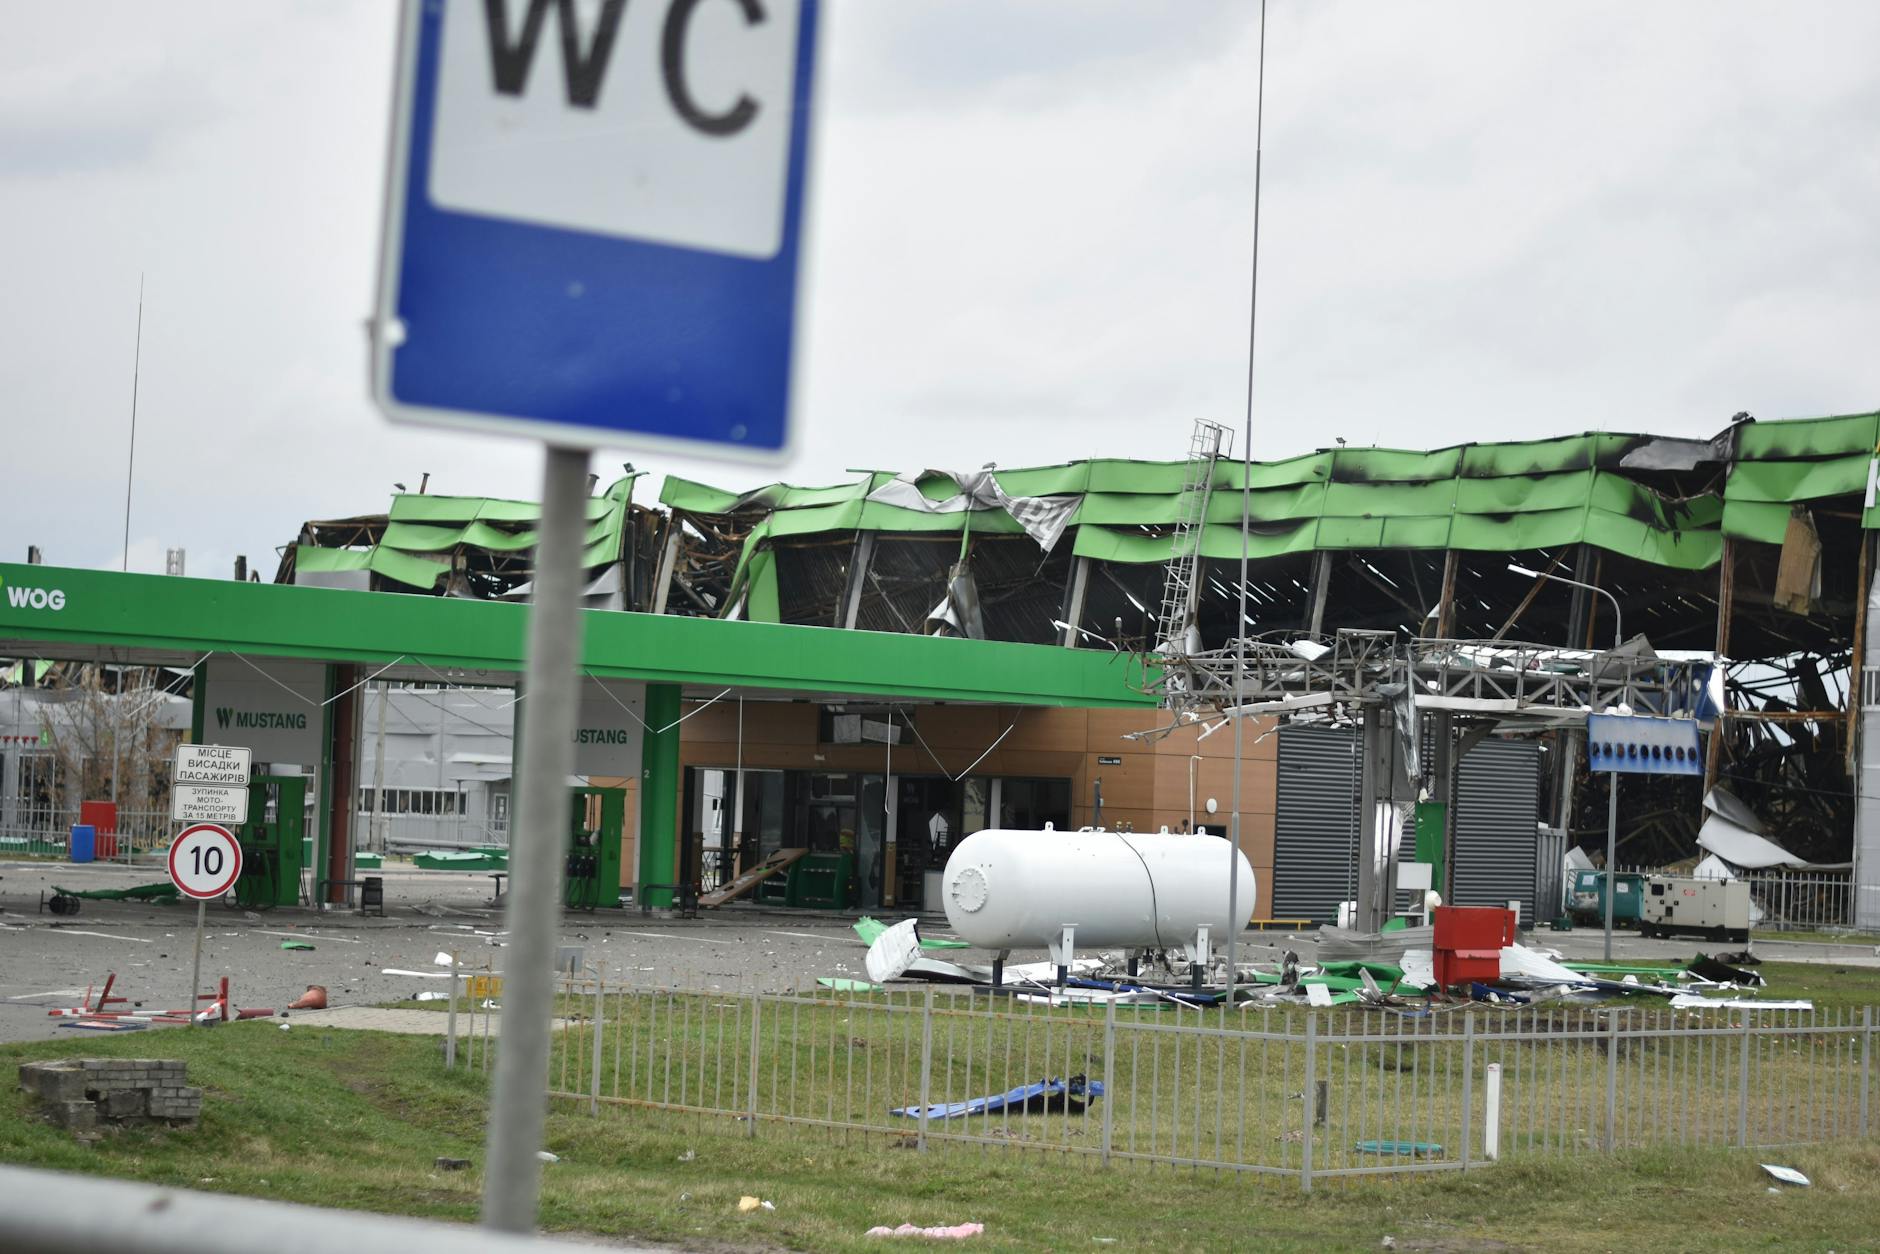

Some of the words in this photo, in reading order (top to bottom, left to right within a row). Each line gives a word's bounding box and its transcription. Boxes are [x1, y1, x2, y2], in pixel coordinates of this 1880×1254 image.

[483, 0, 767, 137] WC
[7, 586, 66, 611] WOG
[236, 711, 307, 729] MUSTANG
[570, 729, 627, 744] USTANG
[198, 748, 232, 760] МІСЦЕ
[188, 759, 240, 770] ВИСАДКИ
[180, 771, 245, 782] ПАСАЖИРІВ
[192, 788, 229, 796] ЗУПИНКА
[197, 796, 223, 804] МОТО-
[184, 804, 236, 812] ТРАНСПОРТУ
[207, 812, 236, 820] МЕТРІВ
[190, 846, 223, 876] 10
